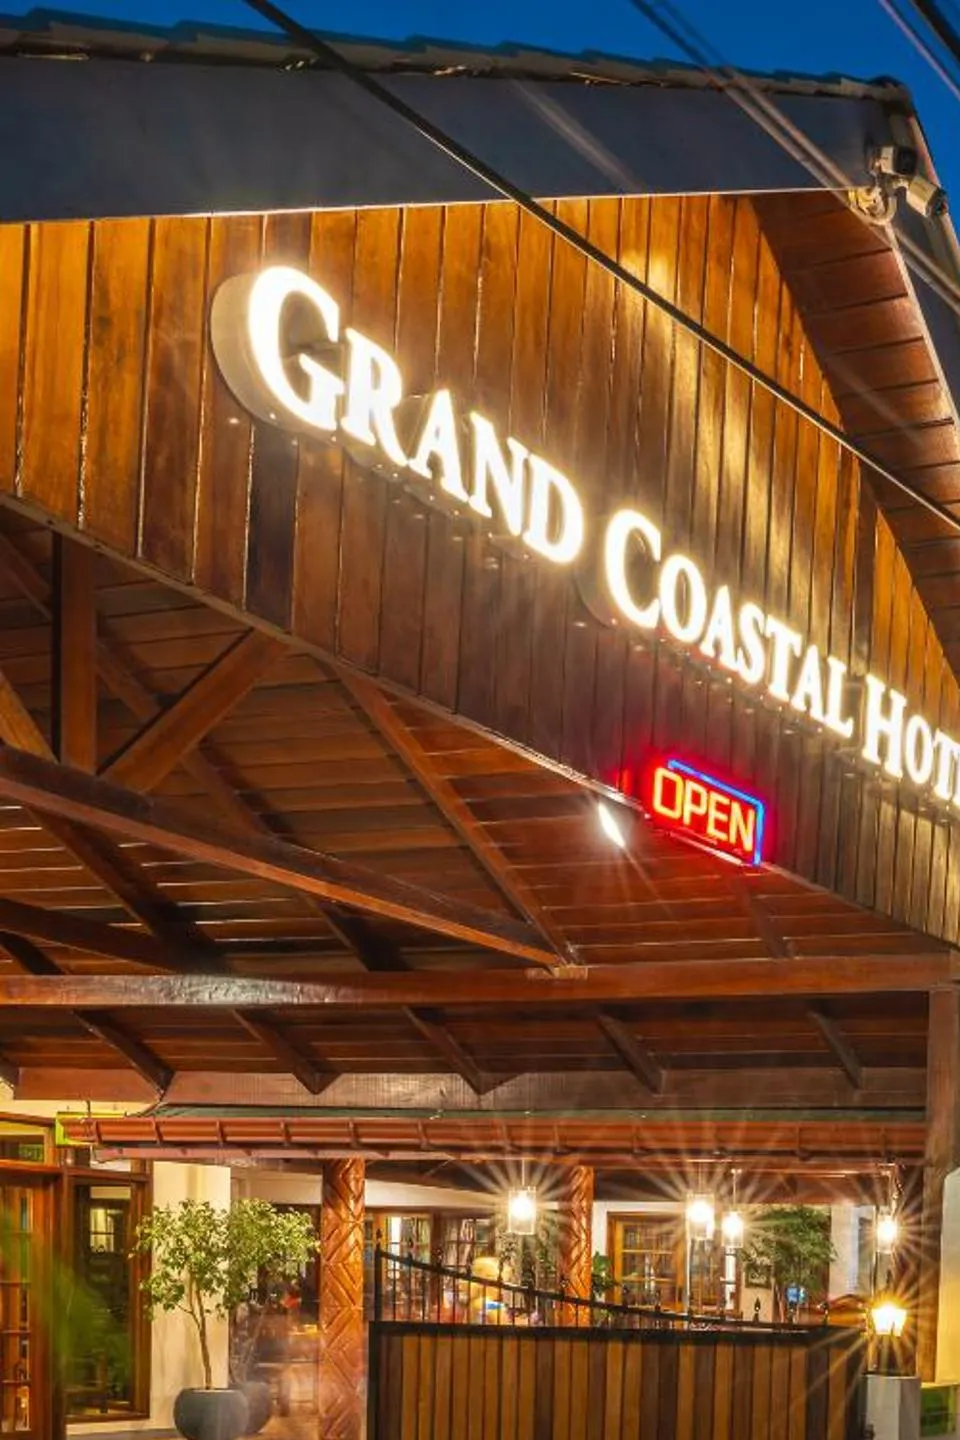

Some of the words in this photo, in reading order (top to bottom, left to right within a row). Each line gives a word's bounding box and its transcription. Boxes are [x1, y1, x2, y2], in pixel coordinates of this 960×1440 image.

[247, 265, 585, 564] GRAND
[604, 508, 854, 739] COASTAL
[652, 766, 757, 853] OPEN
